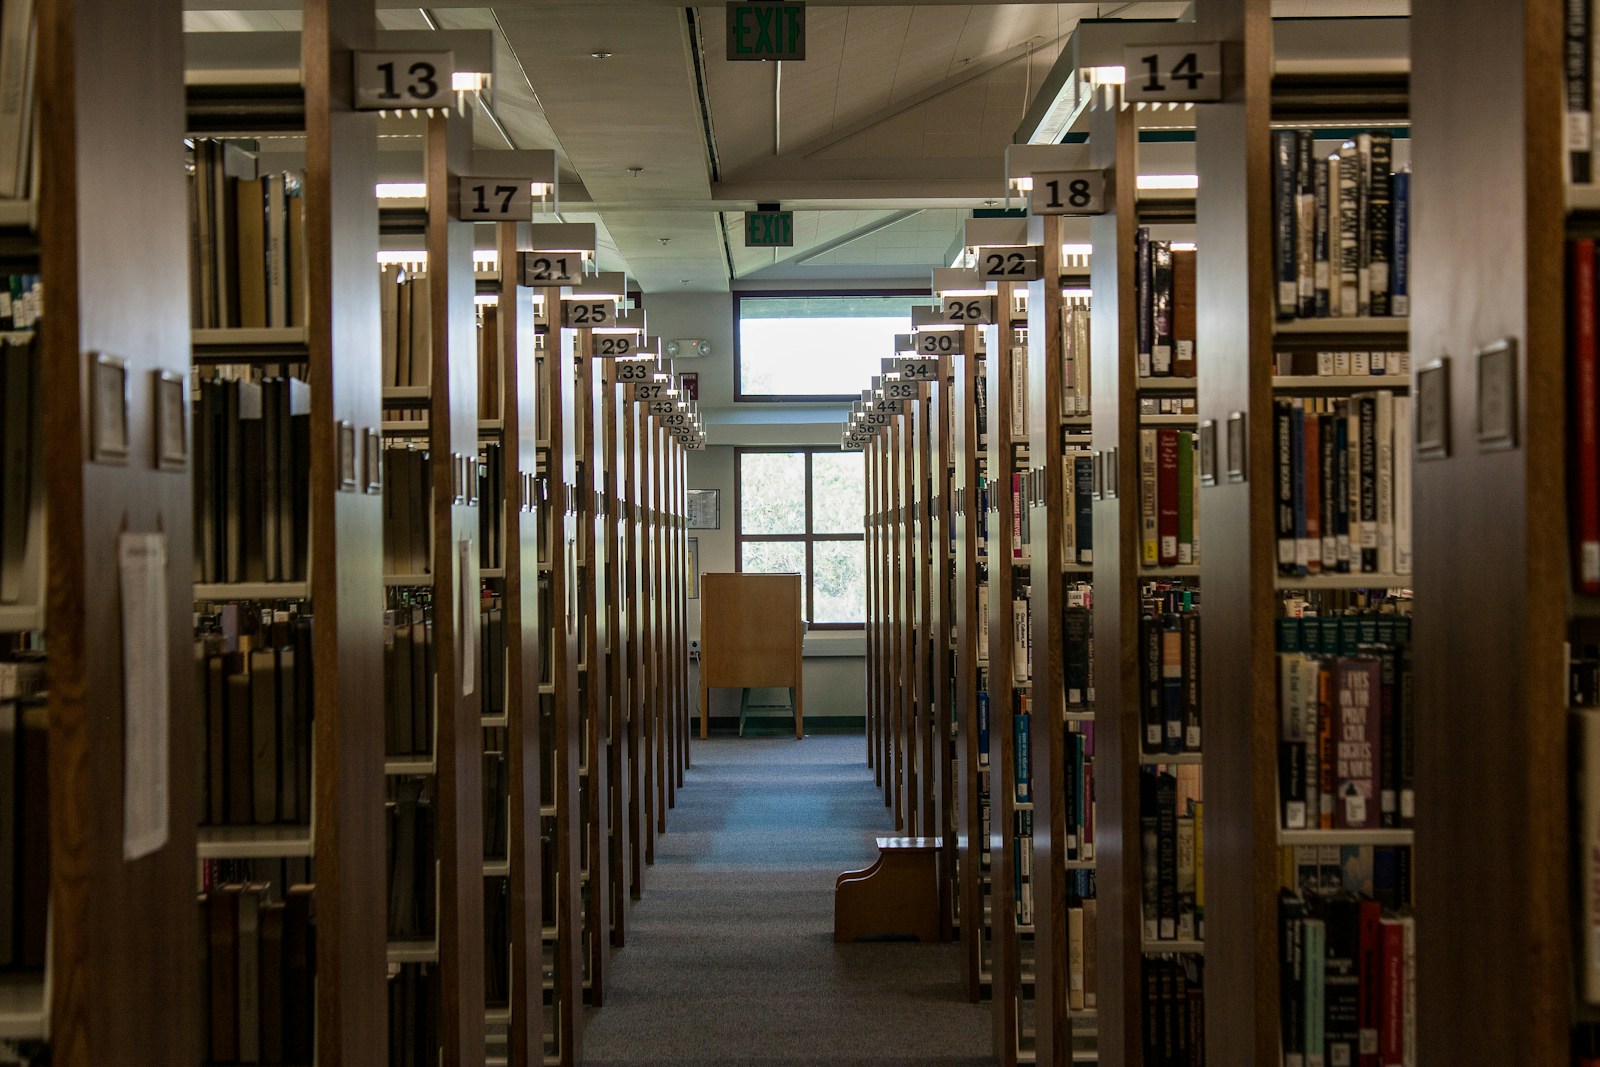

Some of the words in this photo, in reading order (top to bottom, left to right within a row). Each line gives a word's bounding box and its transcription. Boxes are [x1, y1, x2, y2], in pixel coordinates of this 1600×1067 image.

[737, 7, 800, 54] EXIT
[376, 63, 438, 100] 13
[1141, 53, 1204, 92] 14
[471, 185, 519, 214] 17
[1046, 179, 1092, 209] 18
[750, 215, 790, 244] EXIT
[532, 258, 570, 282] 21
[985, 252, 1026, 276] 22
[573, 302, 608, 324] 25
[949, 300, 981, 320] 26
[601, 337, 631, 355] 29
[924, 335, 952, 351] 30
[623, 365, 646, 380] 33
[904, 364, 928, 378] 34
[640, 386, 661, 399] 37
[890, 385, 911, 397] 38
[653, 402, 672, 413] 43
[877, 401, 897, 412] 44
[667, 415, 684, 425] 49
[868, 415, 885, 424] 50
